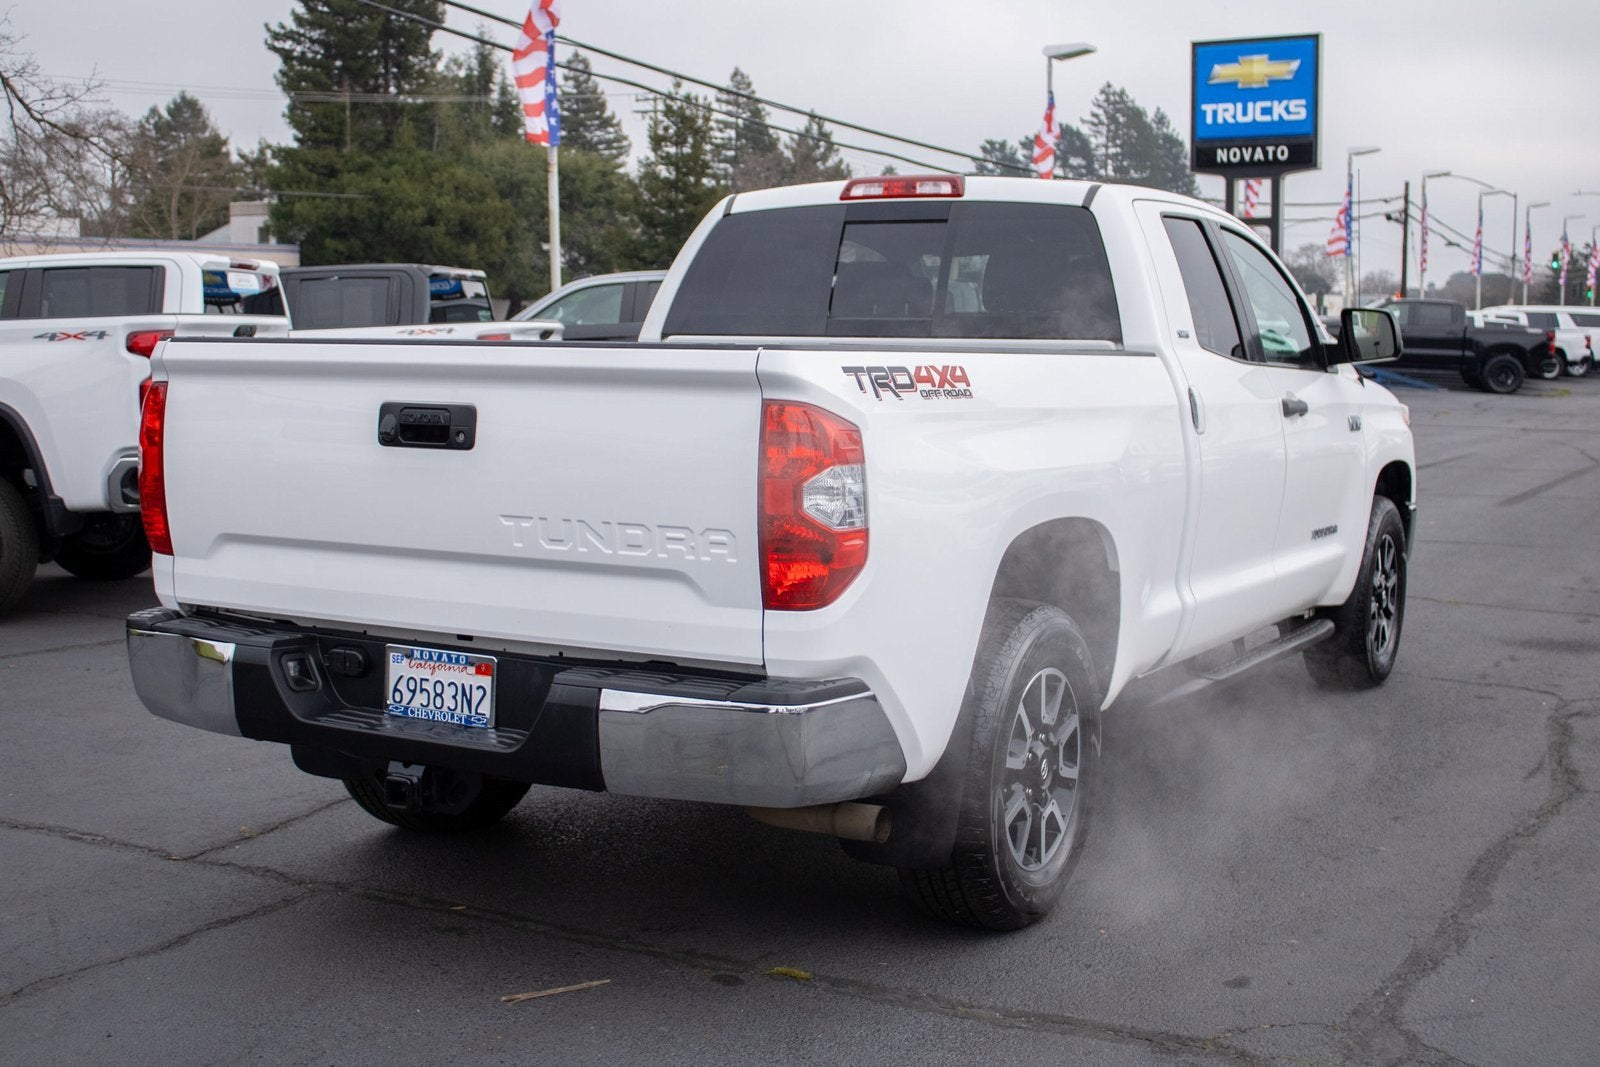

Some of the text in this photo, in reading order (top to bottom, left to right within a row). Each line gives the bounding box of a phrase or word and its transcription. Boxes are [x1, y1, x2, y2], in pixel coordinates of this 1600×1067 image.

[1201, 98, 1307, 125] TRUCKS
[1216, 145, 1289, 163] NOVATO
[841, 365, 971, 401] TRD 4X4
[920, 389, 973, 399] OFF ROAD
[401, 412, 445, 424] TOYOTA
[499, 514, 737, 562] TUNDRA
[391, 654, 405, 664] SEP
[413, 649, 466, 664] NOVATO
[408, 659, 473, 676] California
[392, 674, 487, 717] 69583N2
[407, 708, 467, 725] CHEVROLET
